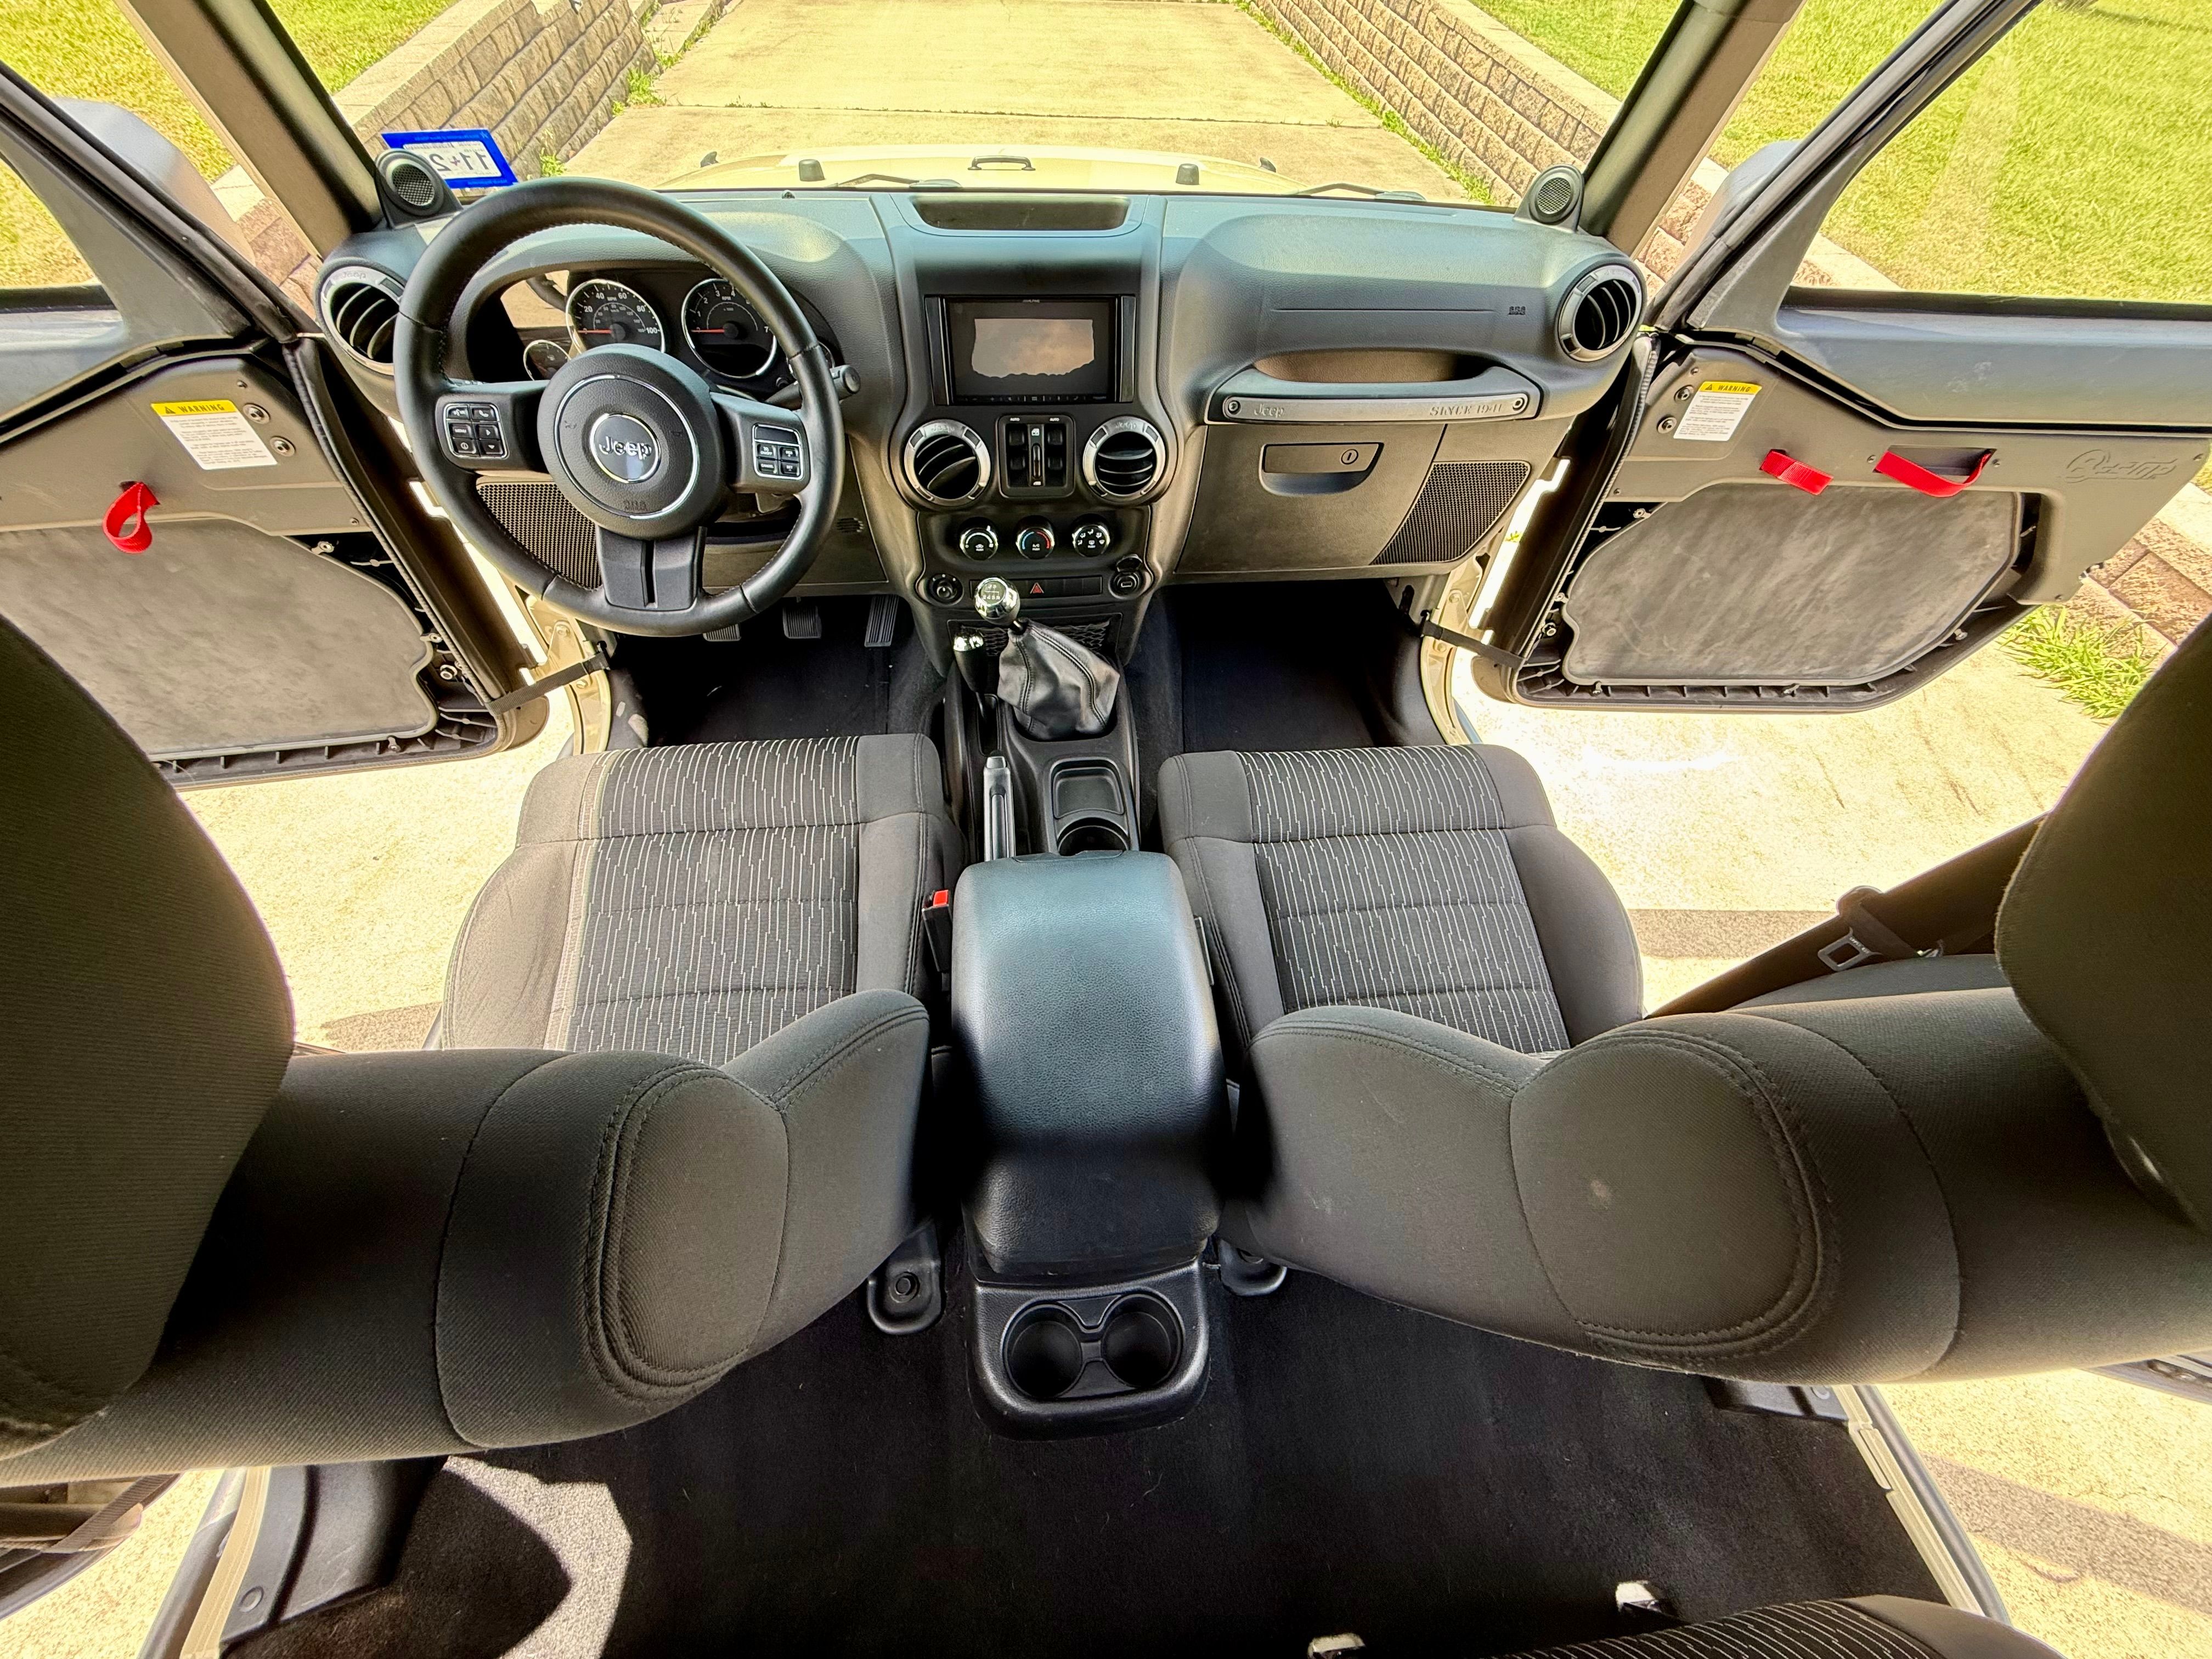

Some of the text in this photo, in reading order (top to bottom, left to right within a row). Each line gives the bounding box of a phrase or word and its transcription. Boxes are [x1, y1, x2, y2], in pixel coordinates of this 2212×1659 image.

[177, 404, 224, 413] WARNING
[1254, 403, 1284, 419] Jeep
[1430, 405, 1472, 416] SINCE
[599, 436, 652, 460] Jeep
